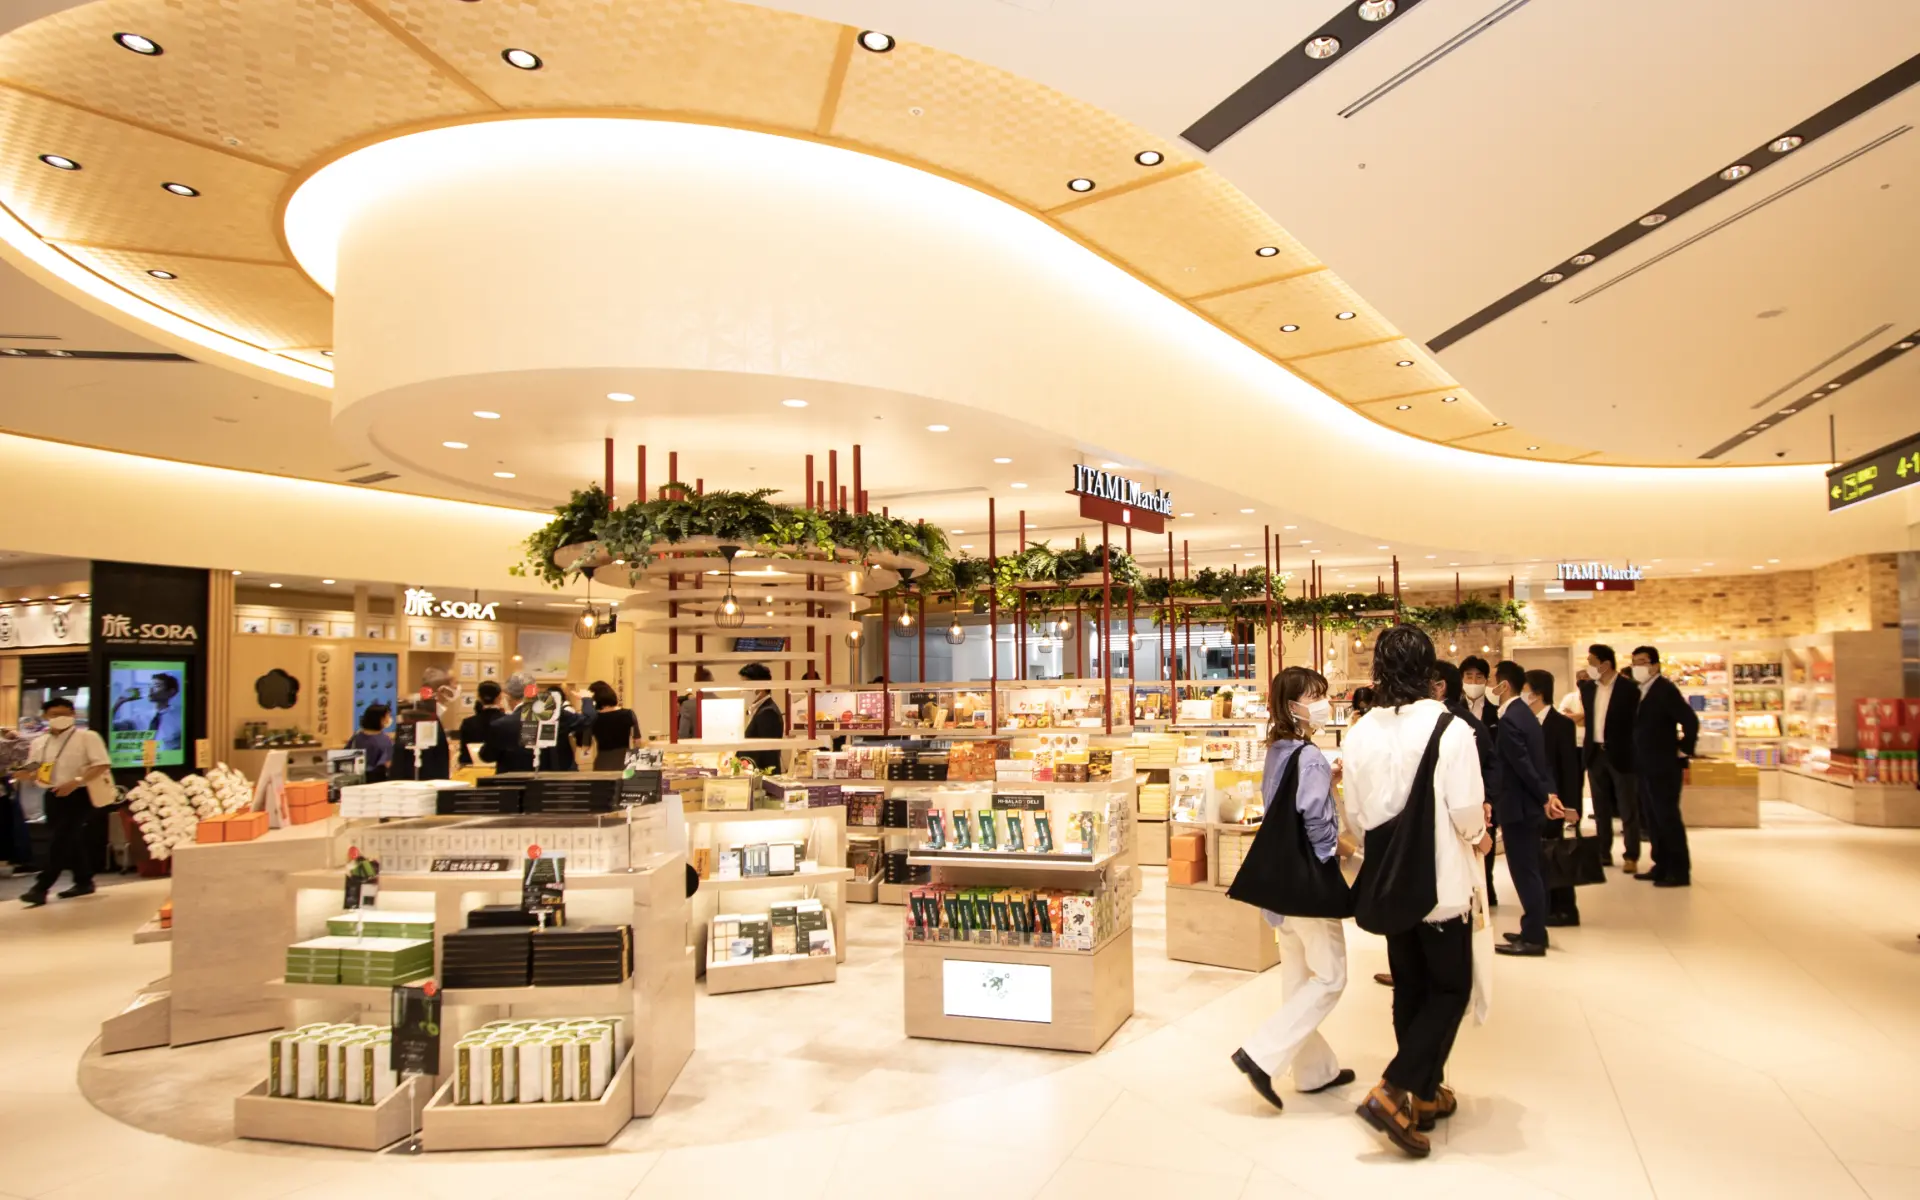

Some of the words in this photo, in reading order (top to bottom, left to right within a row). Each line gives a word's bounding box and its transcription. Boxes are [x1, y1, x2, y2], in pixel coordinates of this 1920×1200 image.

[1073, 464, 1129, 503] ITAMI
[1127, 479, 1172, 515] Marché
[1556, 563, 1600, 580] ITAMI
